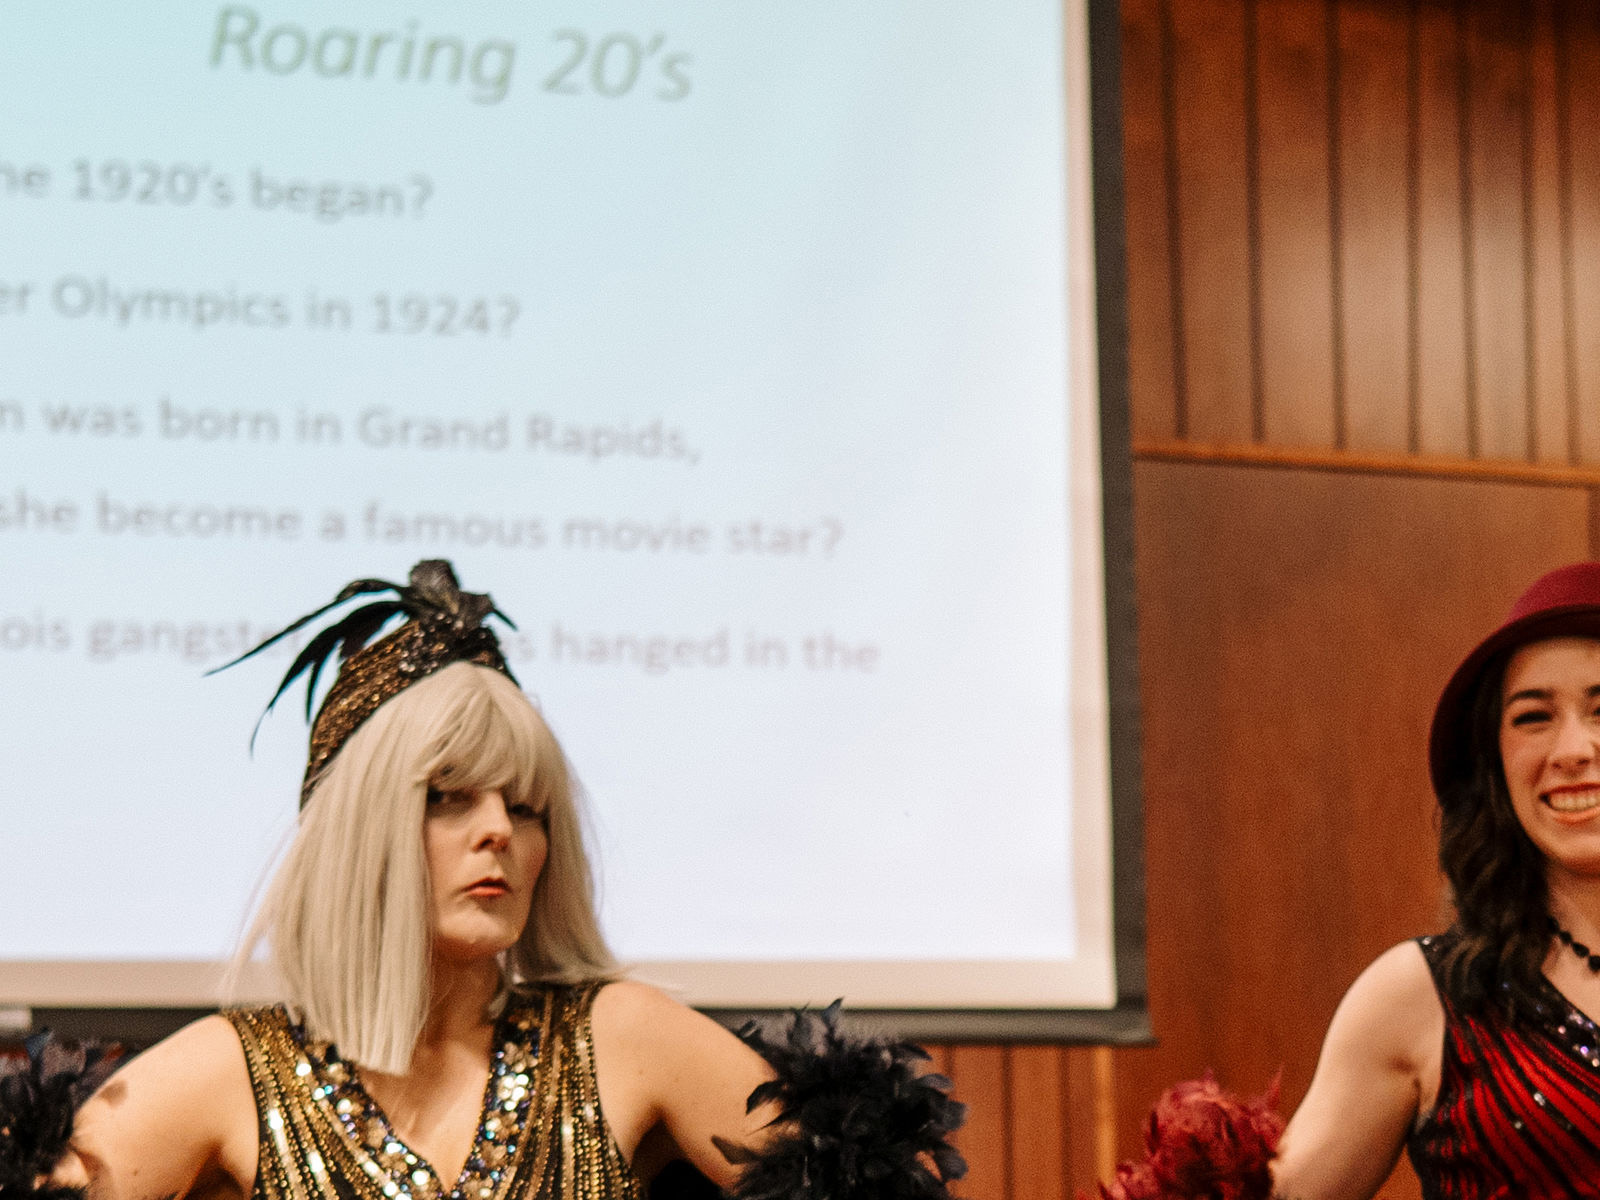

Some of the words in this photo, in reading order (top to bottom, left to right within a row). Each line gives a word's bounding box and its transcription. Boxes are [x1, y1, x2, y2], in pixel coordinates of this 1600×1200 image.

[210, 5, 516, 104] Roaring
[542, 29, 691, 101] 20's
[73, 159, 234, 206] 1920's
[250, 168, 433, 222] began?
[52, 276, 290, 329] Olympics
[306, 293, 351, 328] in
[373, 293, 520, 335] 1924?
[43, 405, 141, 435] was
[159, 397, 278, 440] born
[296, 408, 341, 442] in
[357, 407, 509, 450] Grand
[526, 413, 698, 463] Rapids,
[97, 492, 301, 539] become
[320, 511, 346, 541] a
[363, 500, 545, 545] famous
[563, 512, 710, 552] movie
[727, 517, 843, 557] star?
[551, 622, 728, 674] hanged
[745, 630, 787, 667] in
[802, 632, 879, 671] the
